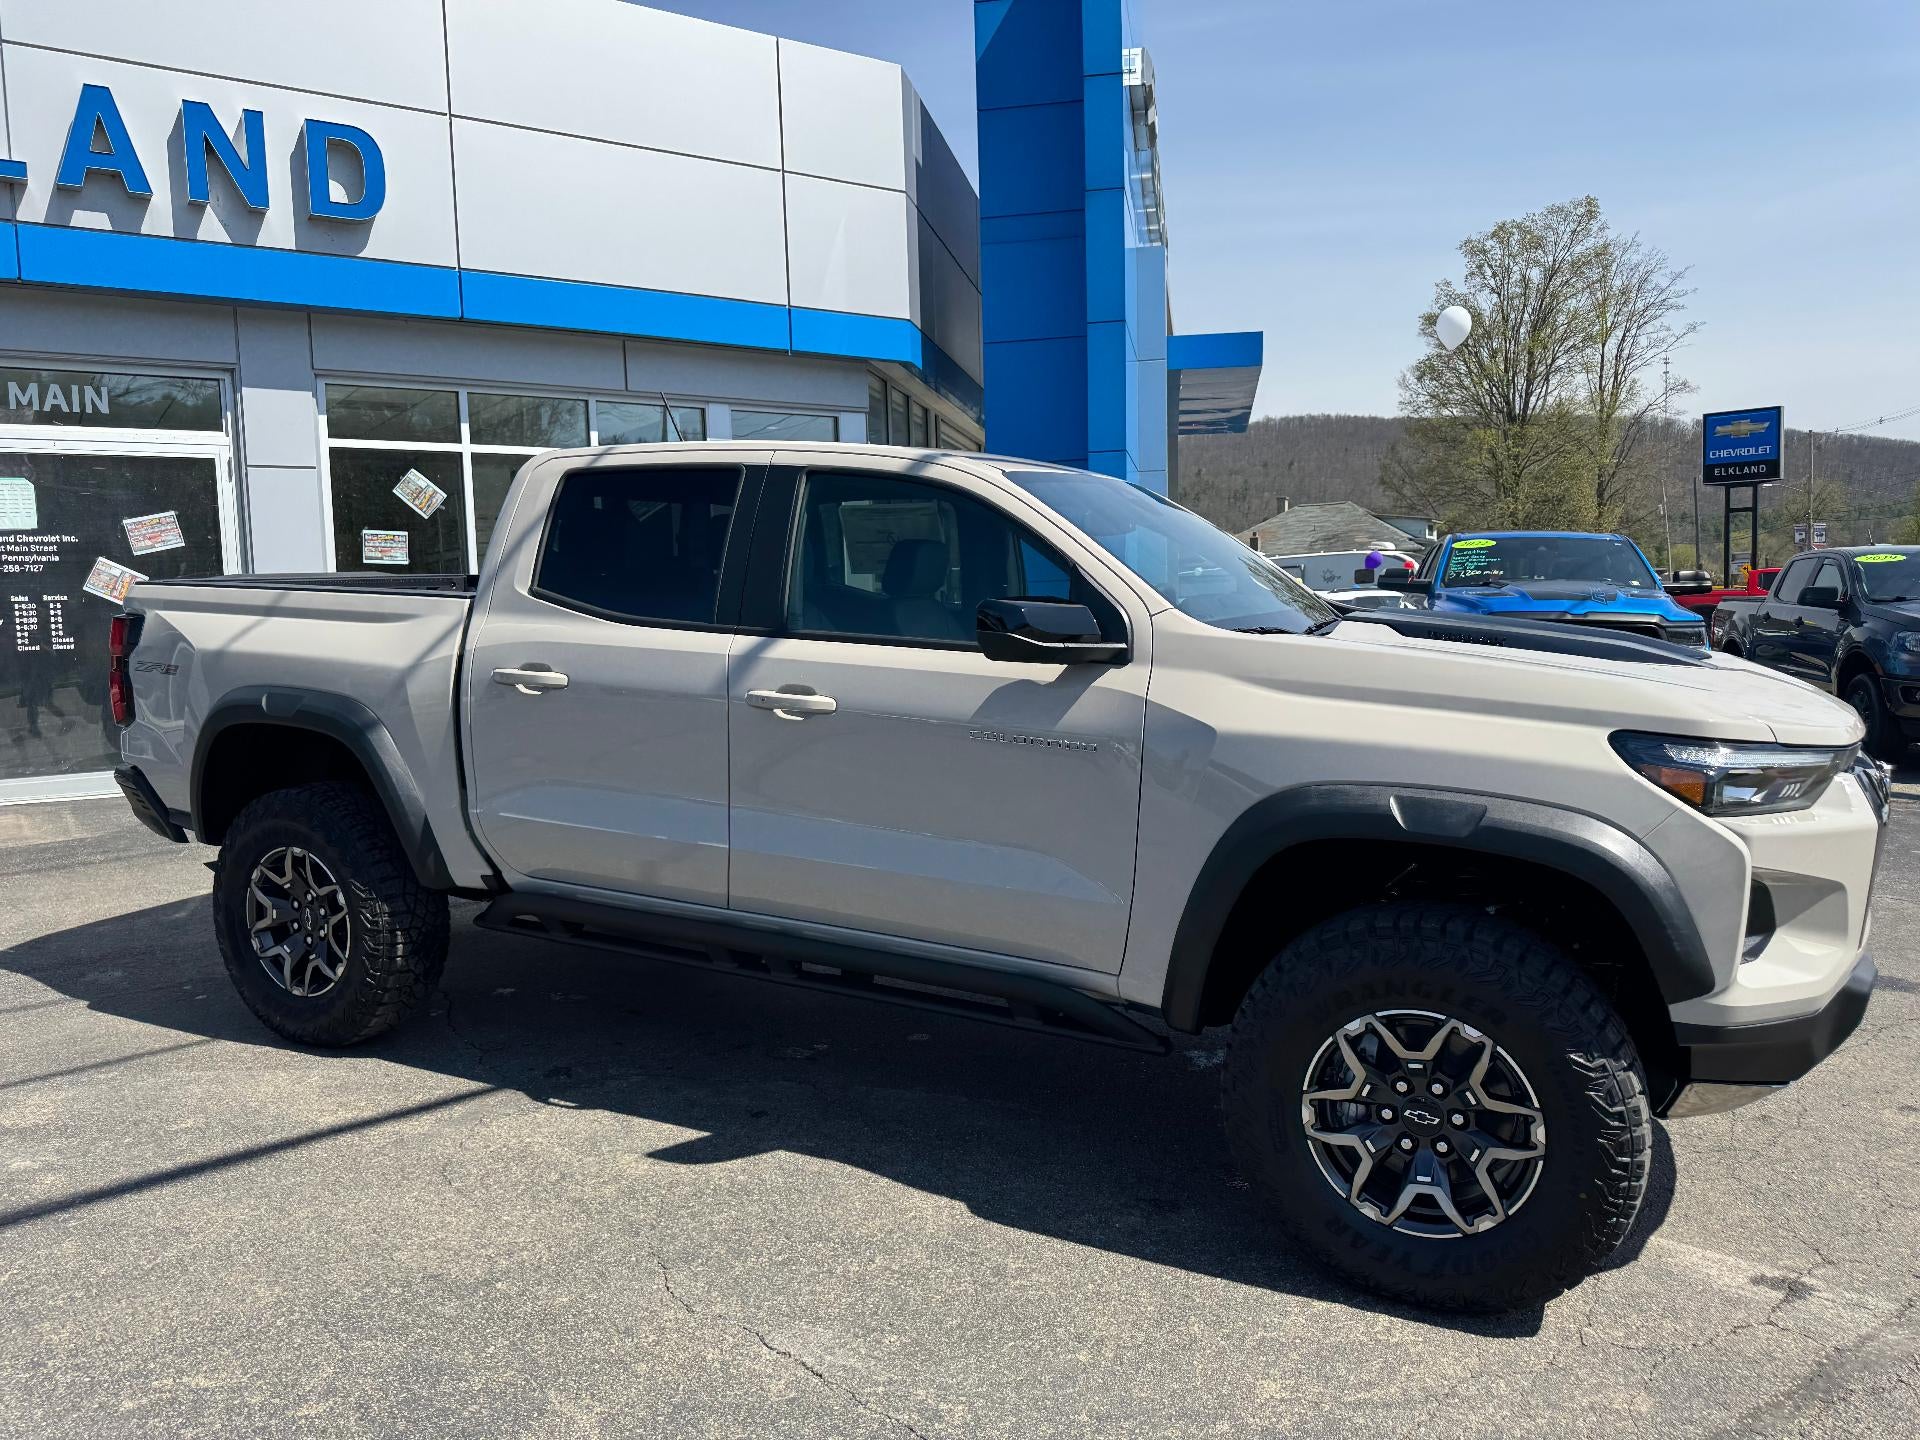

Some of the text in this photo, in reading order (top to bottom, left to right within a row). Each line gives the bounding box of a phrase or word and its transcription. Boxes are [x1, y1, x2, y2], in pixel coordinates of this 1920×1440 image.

[7, 381, 110, 414] MAIN
[1709, 445, 1772, 459] CHEVROLET
[1714, 464, 1767, 476] ELKLAND
[16, 534, 61, 542] Chevrolet
[62, 534, 79, 543] Inc.
[2, 554, 60, 563] Pennsylvania
